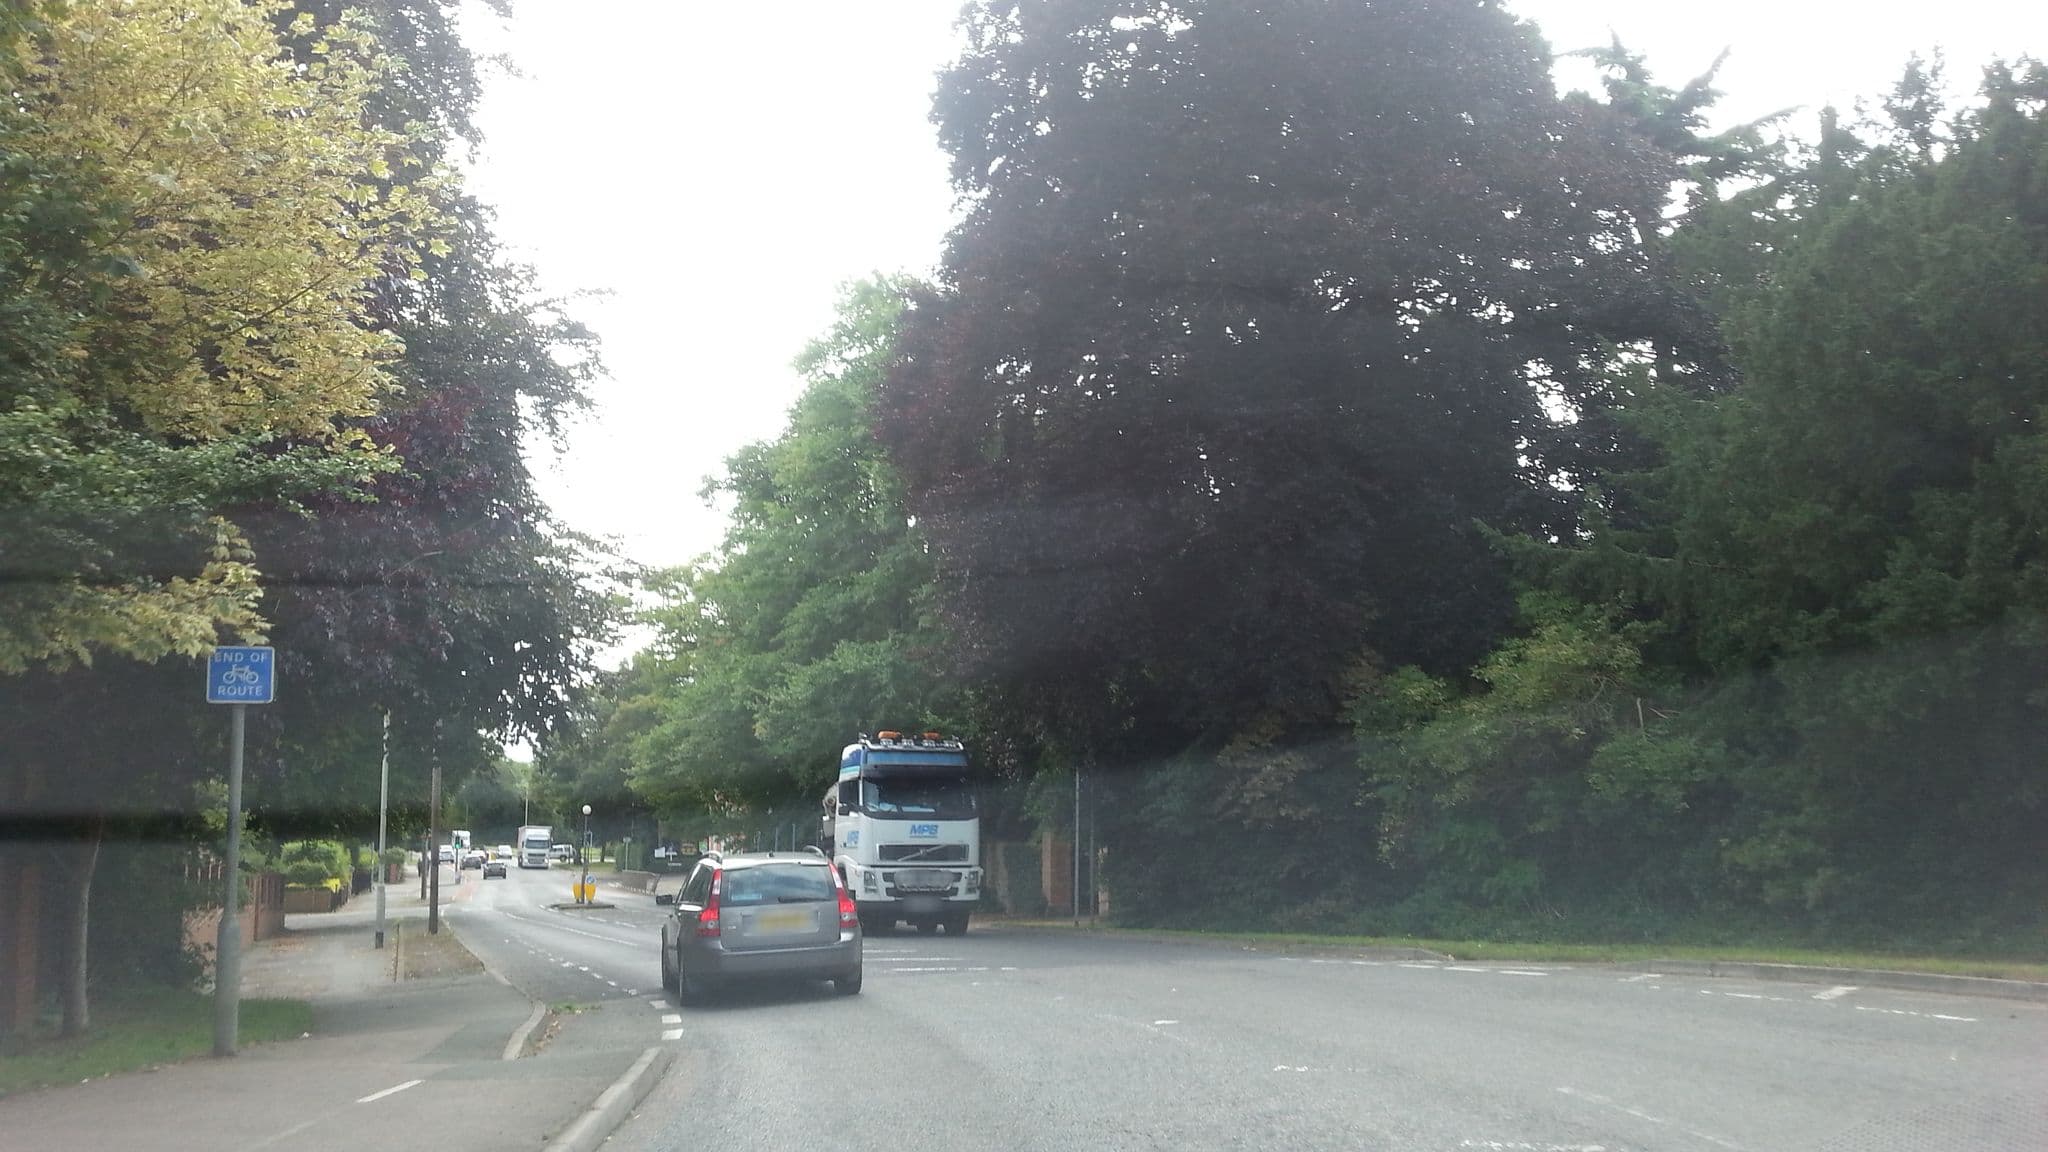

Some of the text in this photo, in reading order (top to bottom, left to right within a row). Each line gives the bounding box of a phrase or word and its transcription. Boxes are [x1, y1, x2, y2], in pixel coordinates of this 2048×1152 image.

[214, 652, 268, 663] END OF
[217, 686, 263, 696] ROUTE
